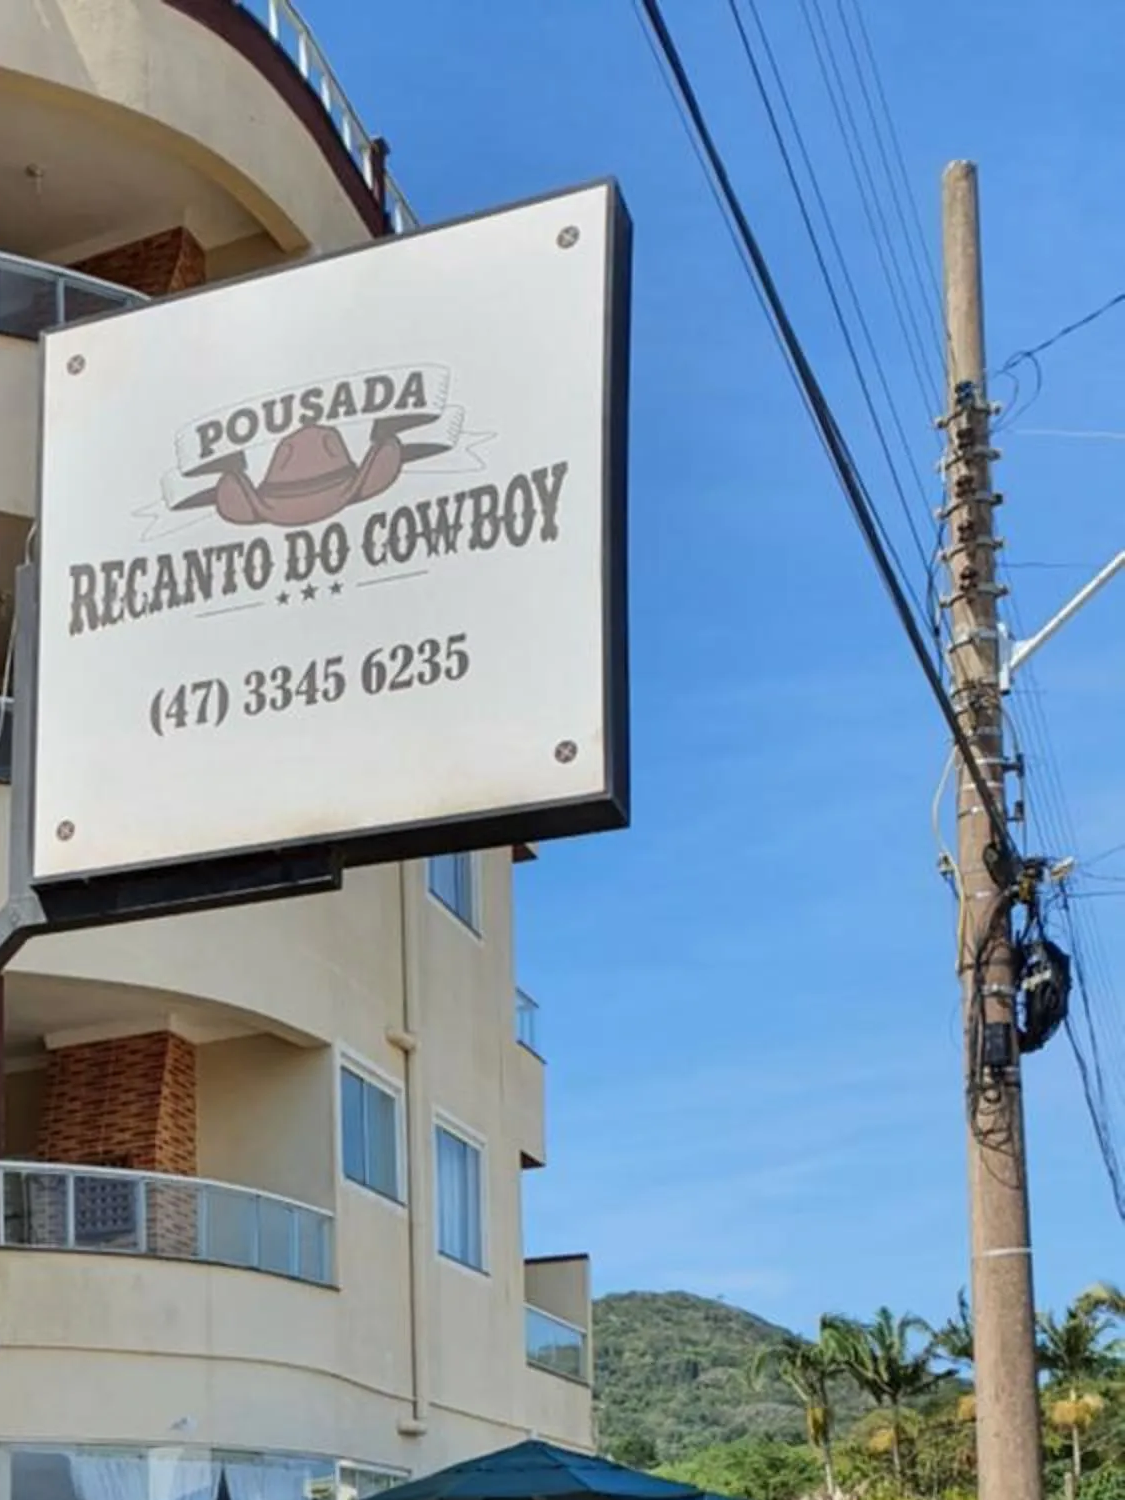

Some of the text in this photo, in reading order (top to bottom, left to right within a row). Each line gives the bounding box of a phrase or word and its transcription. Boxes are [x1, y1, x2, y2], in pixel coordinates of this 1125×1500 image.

[195, 371, 428, 459] POUSADA
[69, 461, 569, 636] RECANTO DO COWBOY
[149, 633, 469, 736] (47) 3345 6235
